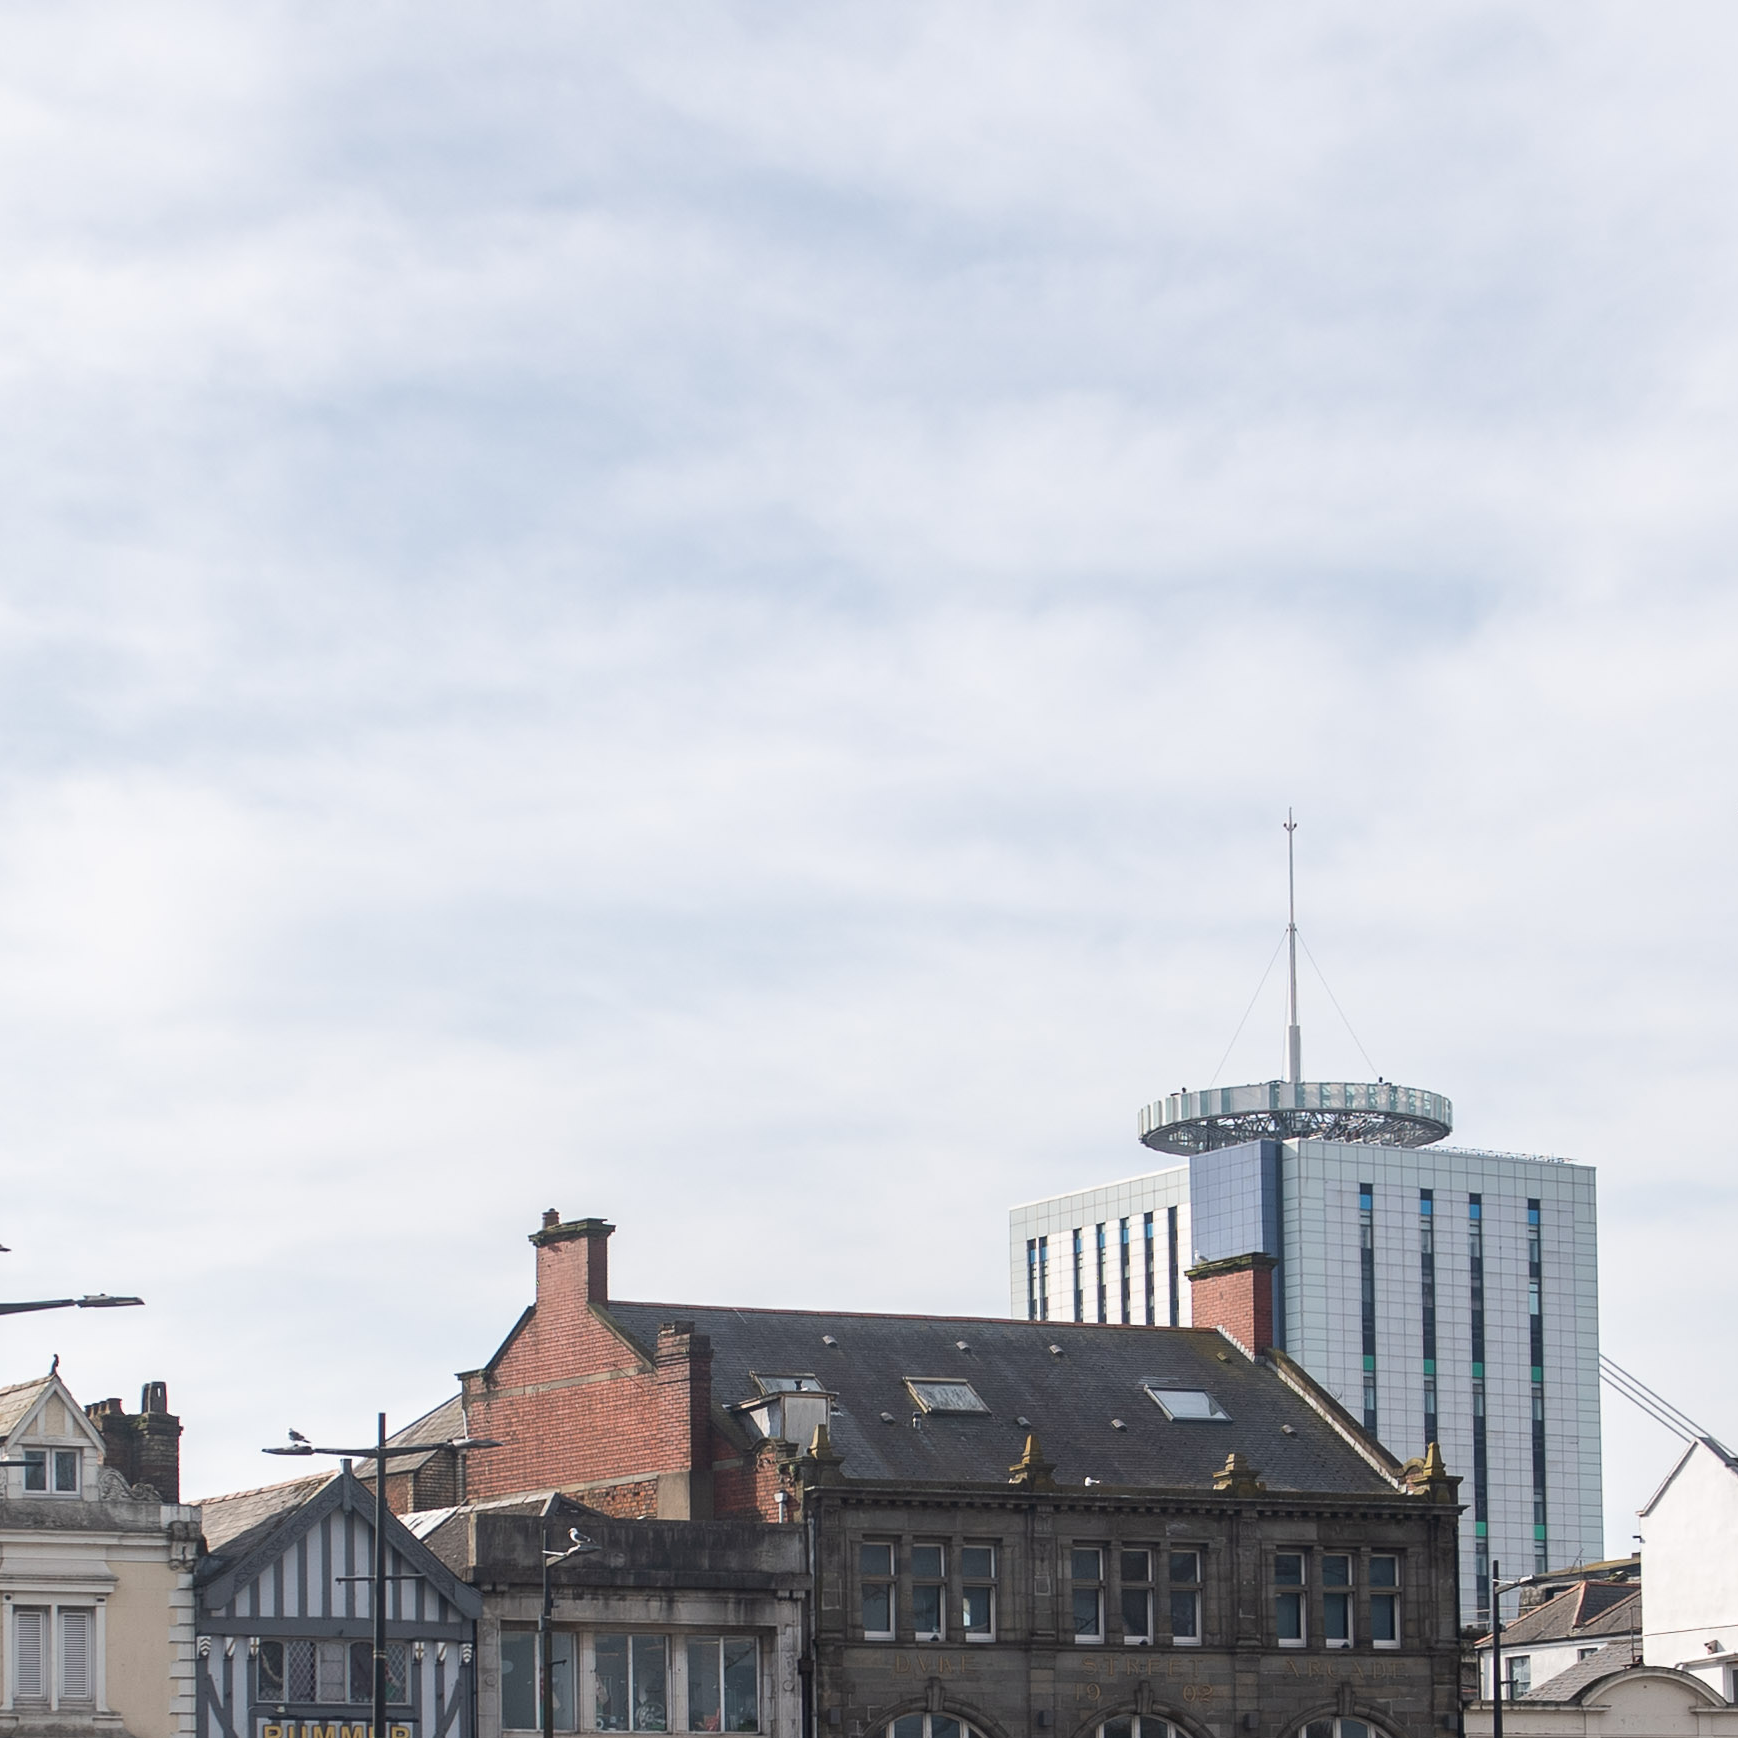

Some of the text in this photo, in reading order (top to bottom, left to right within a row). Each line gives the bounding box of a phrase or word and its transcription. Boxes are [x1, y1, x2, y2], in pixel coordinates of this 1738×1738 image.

[1082, 1656, 1203, 1678] STREET
[1287, 1660, 1406, 1680] ARCADE
[1183, 1684, 1214, 1702] 02
